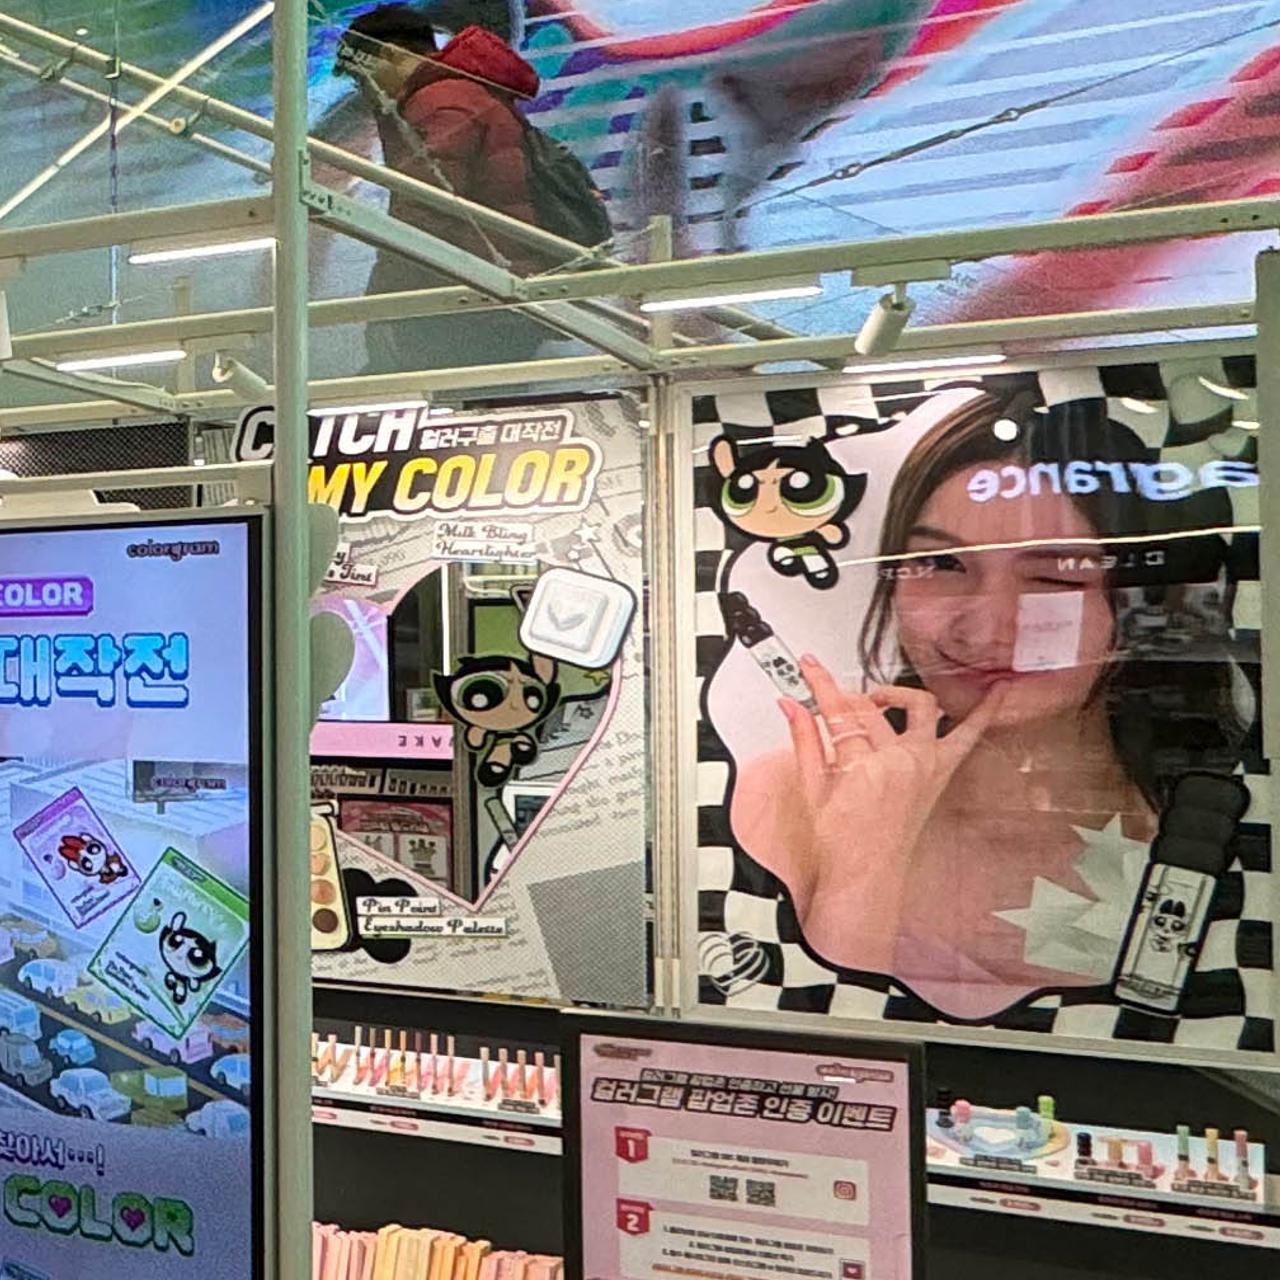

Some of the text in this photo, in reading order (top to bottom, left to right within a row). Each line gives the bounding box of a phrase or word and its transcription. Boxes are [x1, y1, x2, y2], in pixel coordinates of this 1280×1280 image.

[239, 408, 416, 462] CTCH
[501, 419, 563, 444] 대작전
[307, 447, 590, 514] MY COLOR
[126, 540, 220, 561] colorgram
[594, 1080, 893, 1130] 컬러그램 팝업존 인증 이벤트
[2, 1173, 195, 1256] COLOR
[627, 1216, 640, 1232] 2
